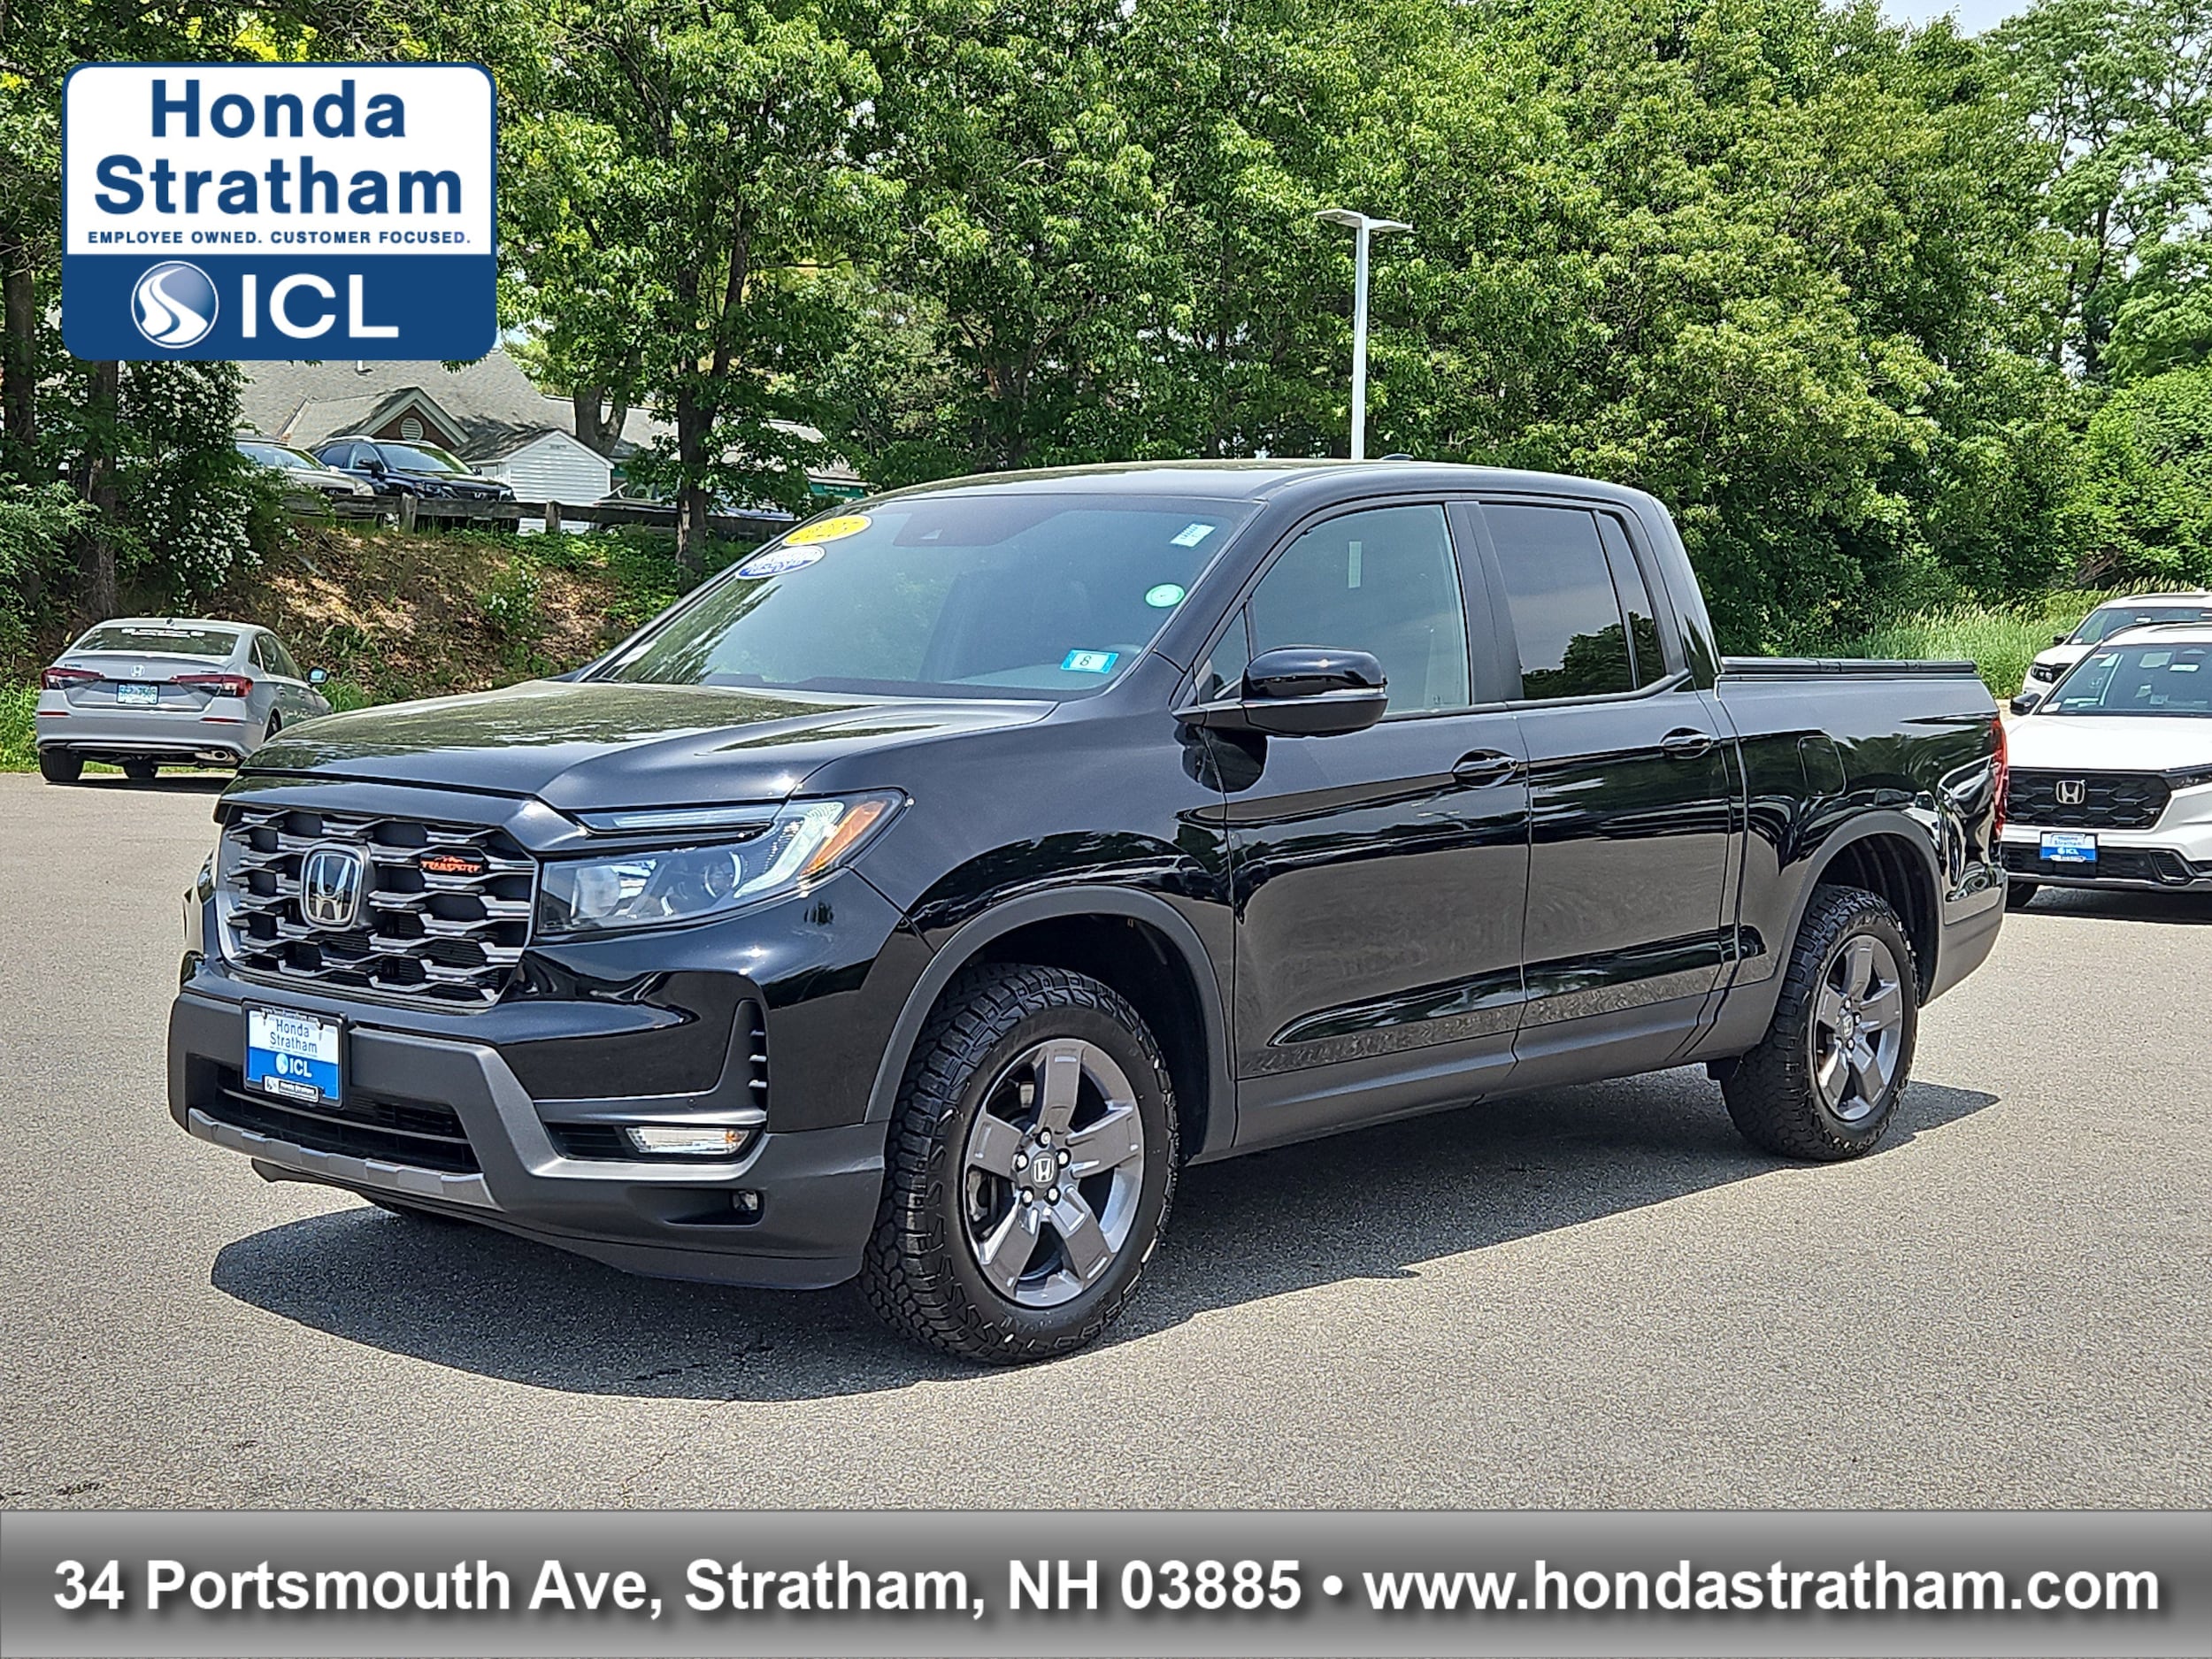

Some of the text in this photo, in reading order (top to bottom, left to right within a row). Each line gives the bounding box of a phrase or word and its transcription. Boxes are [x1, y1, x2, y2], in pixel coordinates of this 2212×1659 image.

[275, 1018, 311, 1038] Honda
[269, 1032, 319, 1054] Stratham
[288, 1057, 313, 1079] ICL
